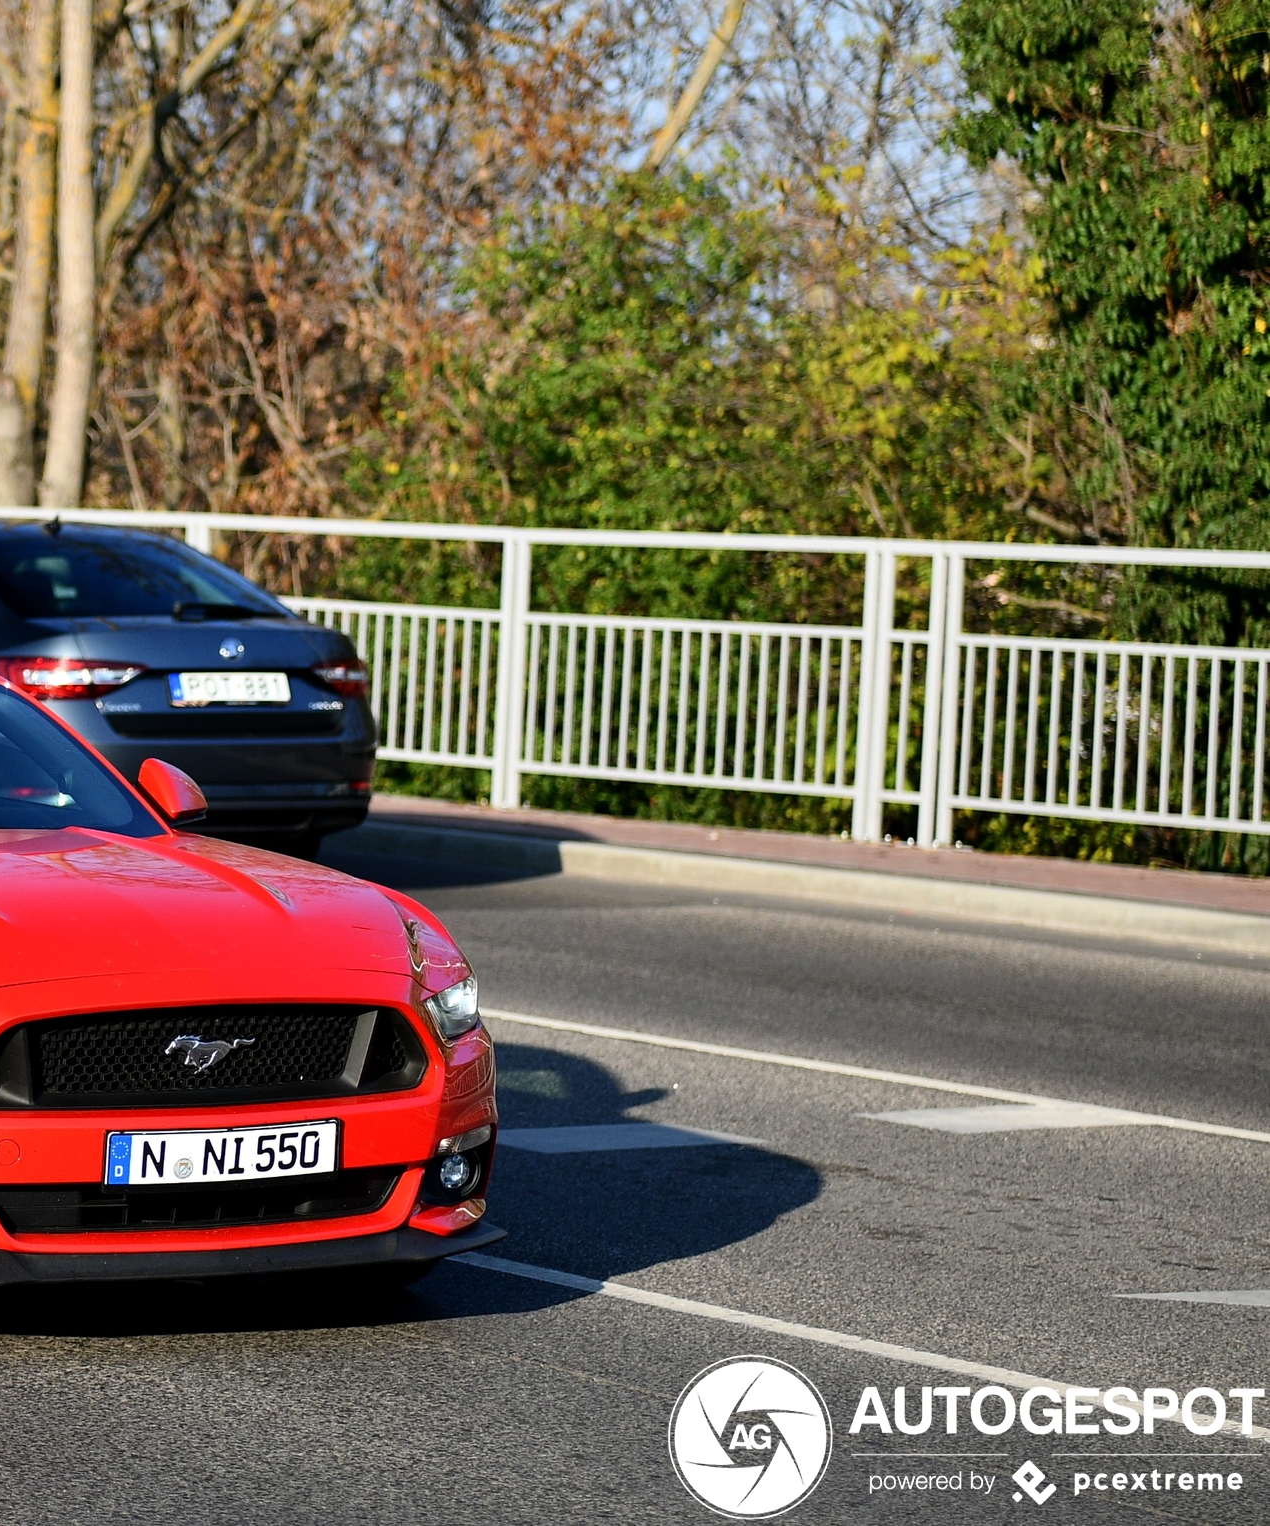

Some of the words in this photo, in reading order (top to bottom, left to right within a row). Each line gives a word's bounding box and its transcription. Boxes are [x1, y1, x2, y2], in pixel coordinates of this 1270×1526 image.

[141, 1140, 166, 1179] N
[202, 1137, 245, 1176] NI
[255, 1130, 320, 1173] 550
[114, 1165, 124, 1178] D
